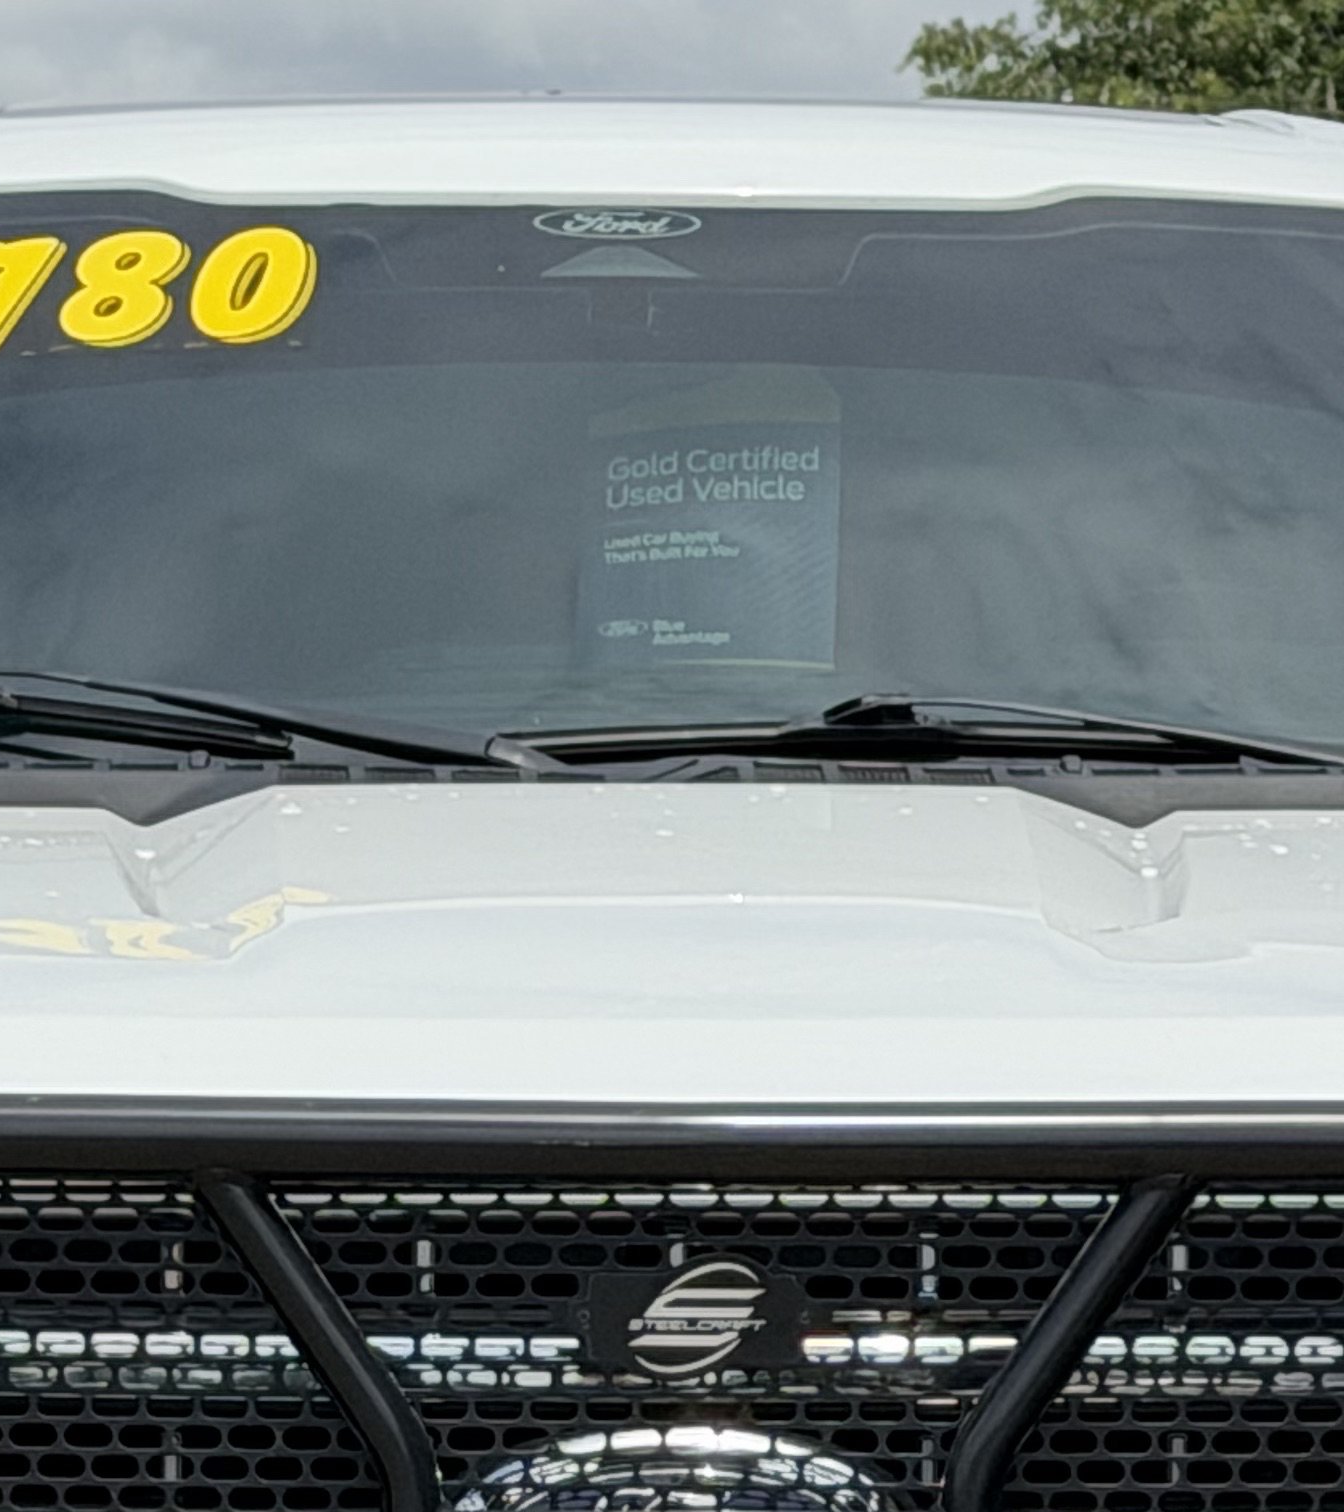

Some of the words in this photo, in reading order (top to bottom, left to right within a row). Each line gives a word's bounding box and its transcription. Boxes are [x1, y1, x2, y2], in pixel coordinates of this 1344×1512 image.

[562, 211, 671, 234] Ford
[608, 451, 678, 480] Gold
[686, 445, 819, 474] Certified
[607, 477, 683, 509] Used
[693, 474, 805, 501] Vehicle
